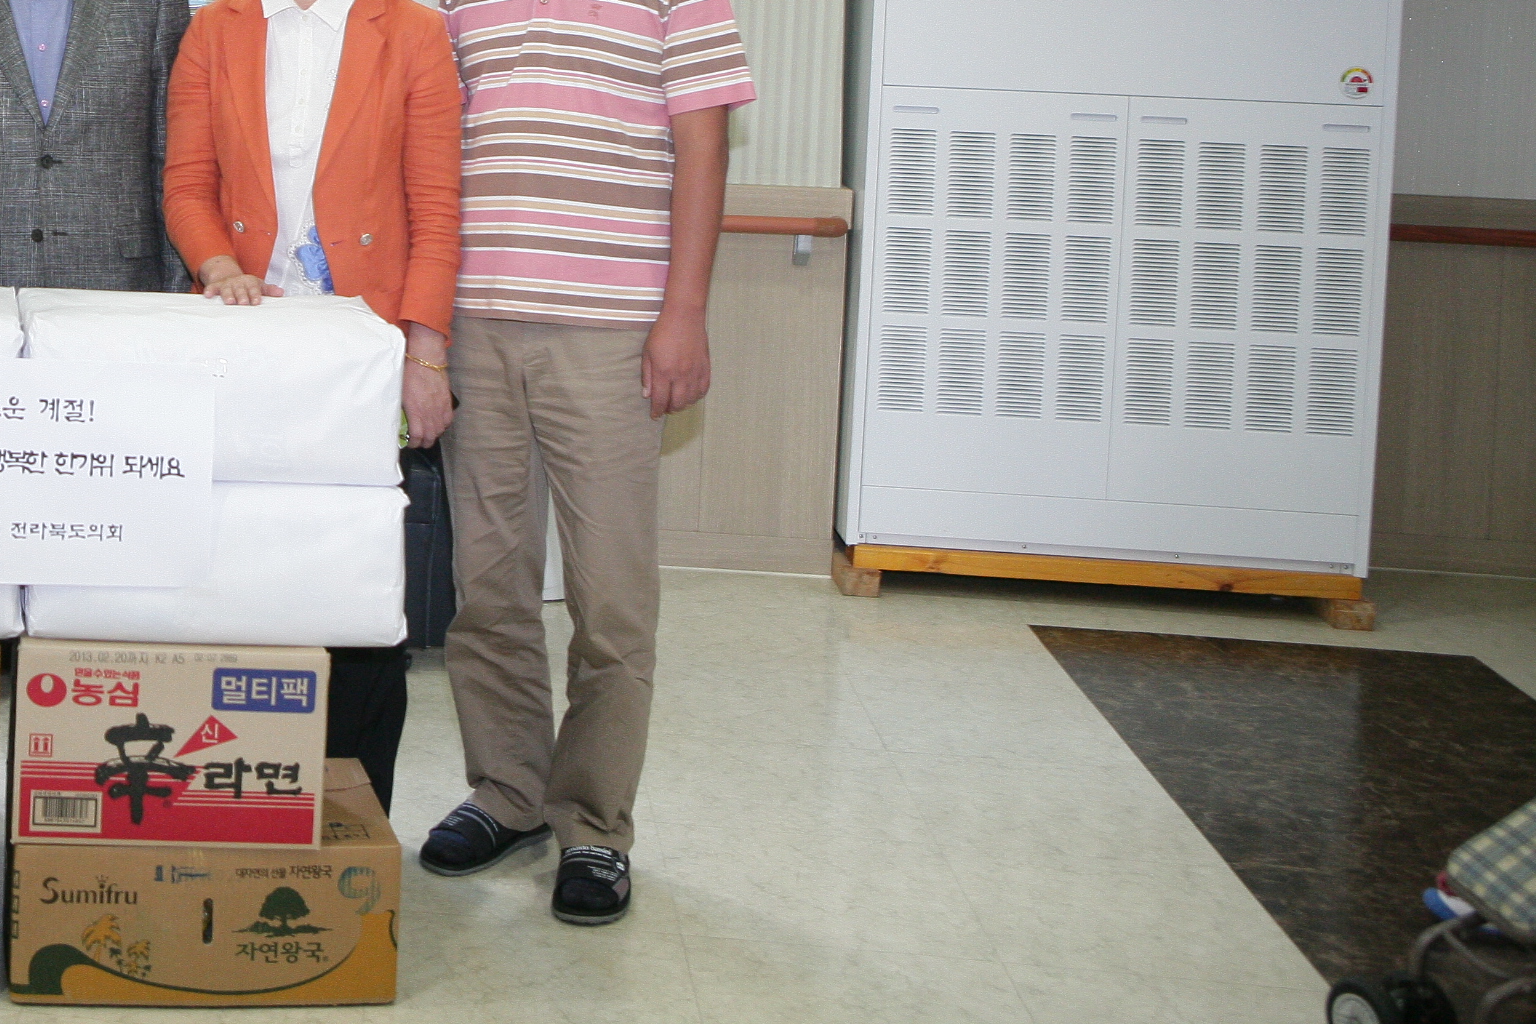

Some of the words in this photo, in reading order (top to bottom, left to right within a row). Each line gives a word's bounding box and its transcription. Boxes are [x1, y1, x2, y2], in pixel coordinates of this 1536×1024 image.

[39, 398, 95, 423] 계절!
[54, 451, 115, 477] 한가위
[122, 455, 185, 480] 되세요
[10, 522, 123, 542] 전라북도의회
[70, 678, 140, 708] 농심
[221, 675, 309, 707] 멀티팩
[200, 723, 220, 744] 신
[95, 712, 197, 826] 辛
[203, 757, 303, 800] 라면
[289, 864, 333, 880] 자연왕국
[39, 876, 138, 905] Sumifru
[234, 941, 325, 964] 자연왕국
